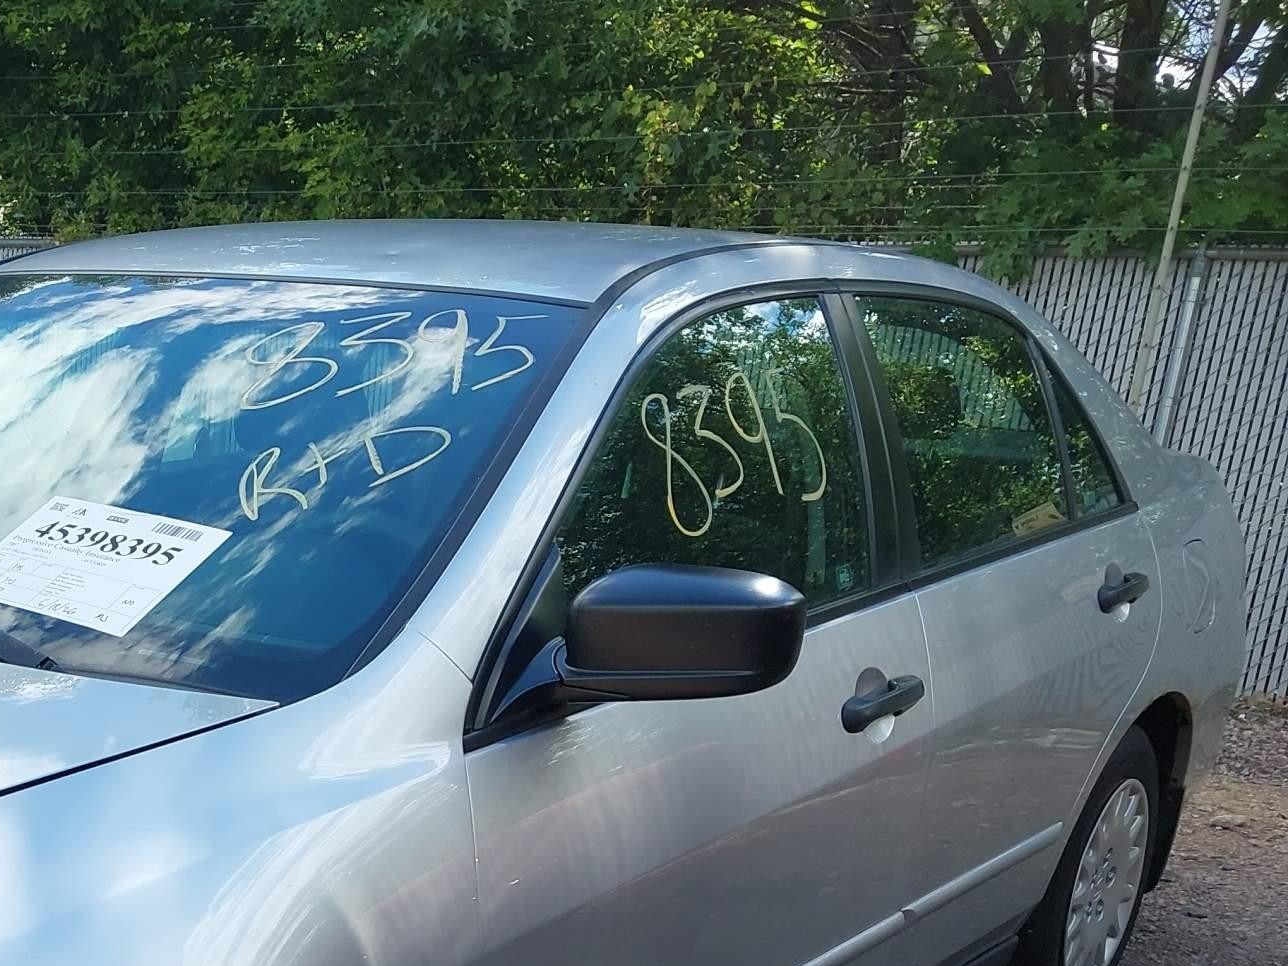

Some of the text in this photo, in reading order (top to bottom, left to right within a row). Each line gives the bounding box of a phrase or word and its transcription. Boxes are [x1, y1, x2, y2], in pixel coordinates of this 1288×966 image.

[240, 308, 550, 410] 8395
[641, 367, 827, 537] 8395
[35, 521, 184, 565] 45398395
